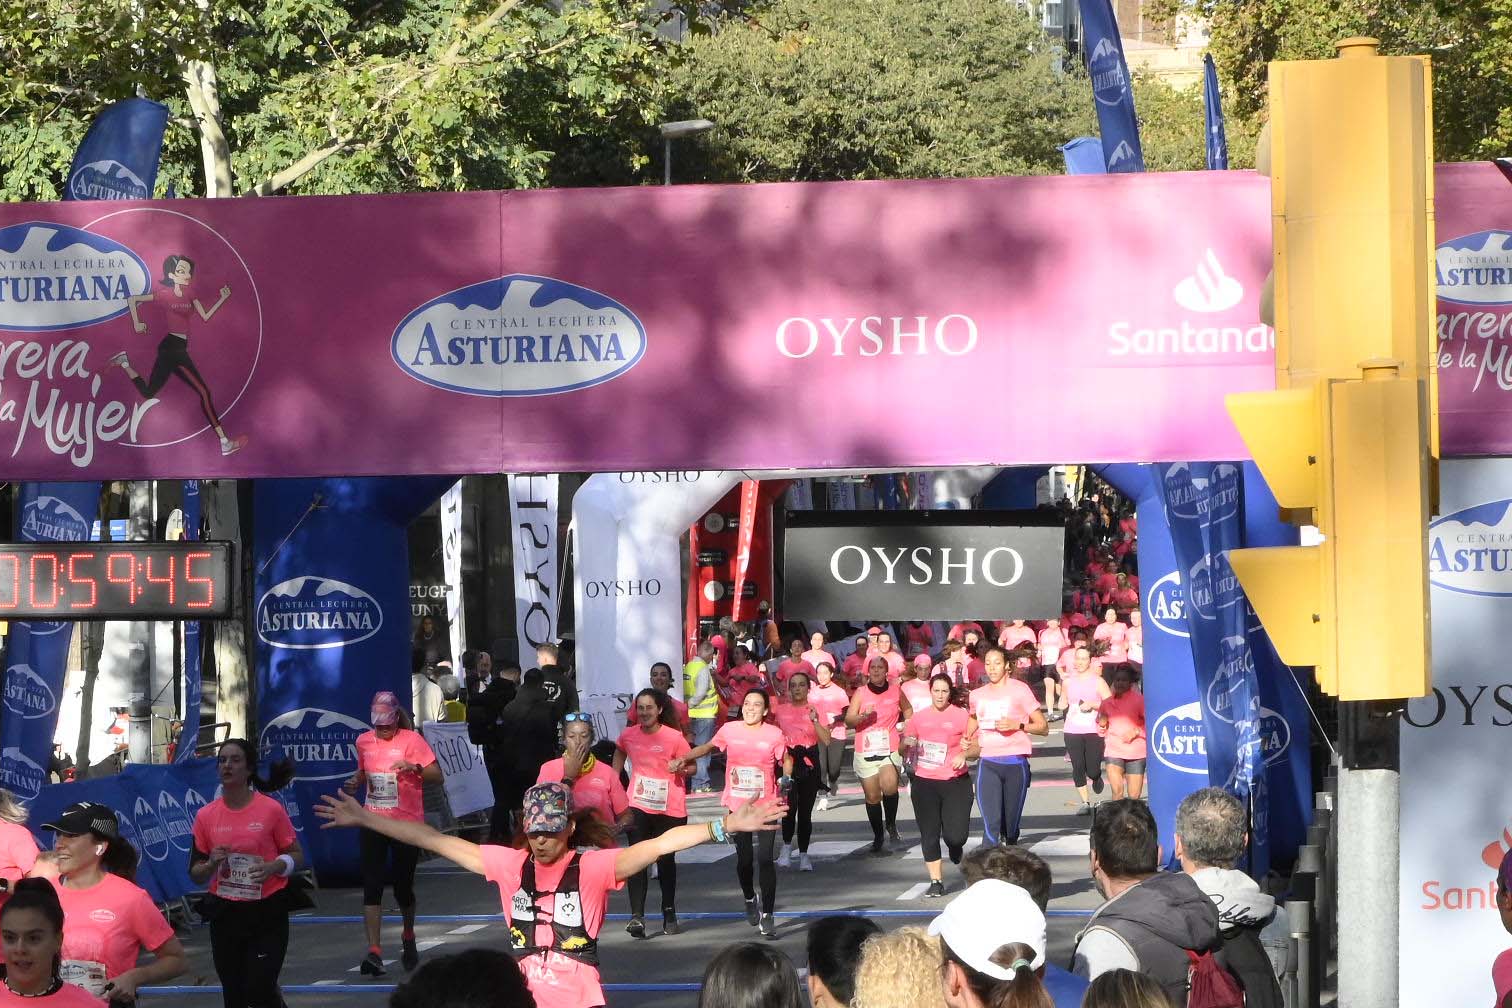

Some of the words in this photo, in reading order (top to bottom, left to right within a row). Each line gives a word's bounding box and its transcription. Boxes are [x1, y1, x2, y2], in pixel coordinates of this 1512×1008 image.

[53, 257, 126, 271] LECHERA
[450, 316, 531, 331] CENTRAL
[536, 314, 619, 329] LECHERA
[775, 313, 978, 360] OYSHO
[1108, 322, 1275, 355] Santand
[1436, 311, 1512, 341] arrer
[412, 322, 626, 367] ASTURIANA
[12, 374, 160, 468] Mujer
[1456, 533, 1512, 543] CENTRA
[514, 475, 550, 649] OYSH
[830, 545, 1024, 587] OYSHO
[585, 578, 661, 599] OYSHO
[260, 606, 374, 633] ASTURIANA
[1401, 685, 1512, 729] OYS
[1174, 724, 1203, 733] CENT
[436, 735, 473, 777] SHO
